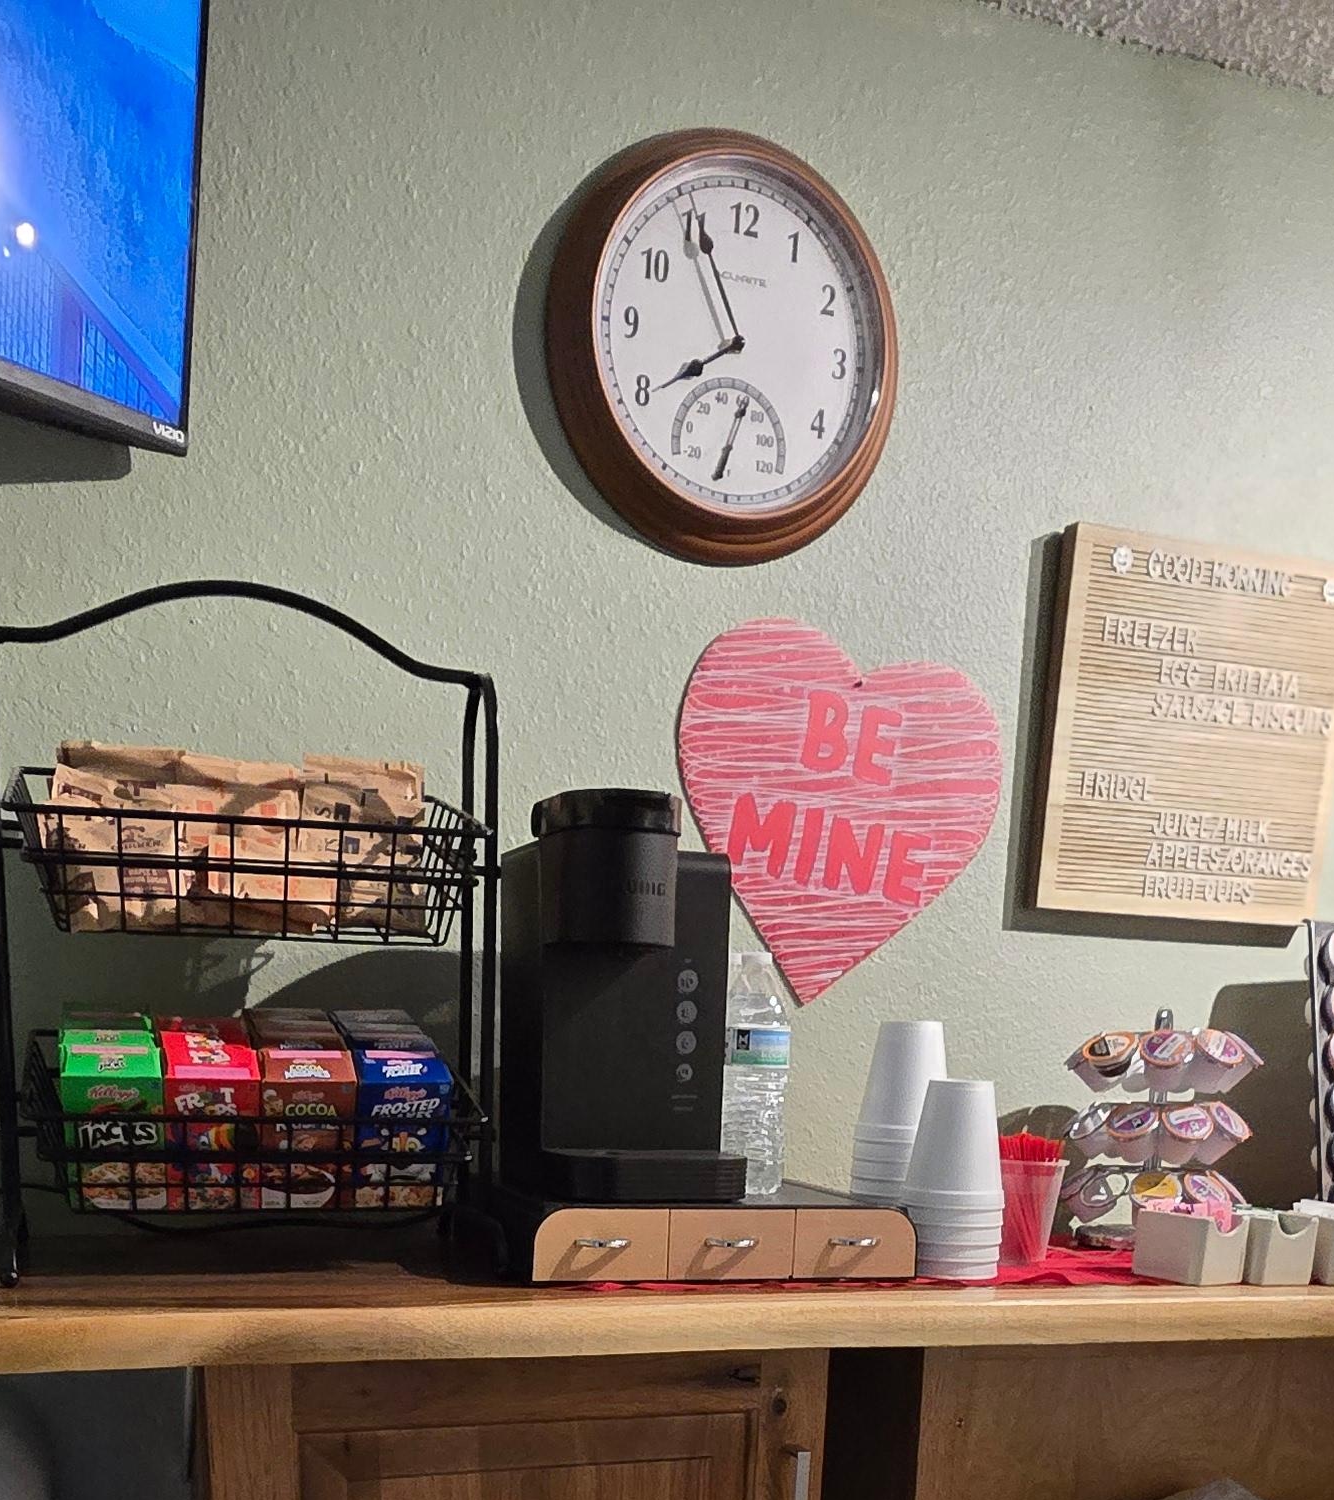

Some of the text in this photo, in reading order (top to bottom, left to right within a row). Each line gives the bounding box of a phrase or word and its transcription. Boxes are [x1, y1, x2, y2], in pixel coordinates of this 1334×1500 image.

[730, 201, 761, 239] 12
[788, 231, 800, 264] 1
[641, 247, 670, 283] 10
[819, 283, 837, 318] 2
[623, 305, 640, 339] 9
[831, 348, 847, 380] 3
[634, 373, 651, 407] 8
[714, 391, 729, 406] 40
[696, 400, 711, 416] 20
[749, 410, 765, 424] 80
[809, 407, 826, 440] 4
[152, 421, 185, 444] VIZIO
[685, 421, 694, 434] 0
[755, 433, 774, 448] 100
[683, 445, 702, 460] -20
[755, 459, 774, 474] 120
[1148, 549, 1293, 597] GOOD MORNING
[1102, 615, 1198, 656] FREEZER
[1158, 658, 1201, 689] EGG
[1152, 691, 1334, 736] SAUSAGE BISCUITS
[800, 689, 903, 787] BE
[1080, 771, 1153, 801] FRIDGE
[727, 792, 932, 907] MINE
[1142, 873, 1253, 905] FRUIT CUPS
[285, 1103, 338, 1117] COCOA
[370, 1097, 441, 1118] FROSTED
